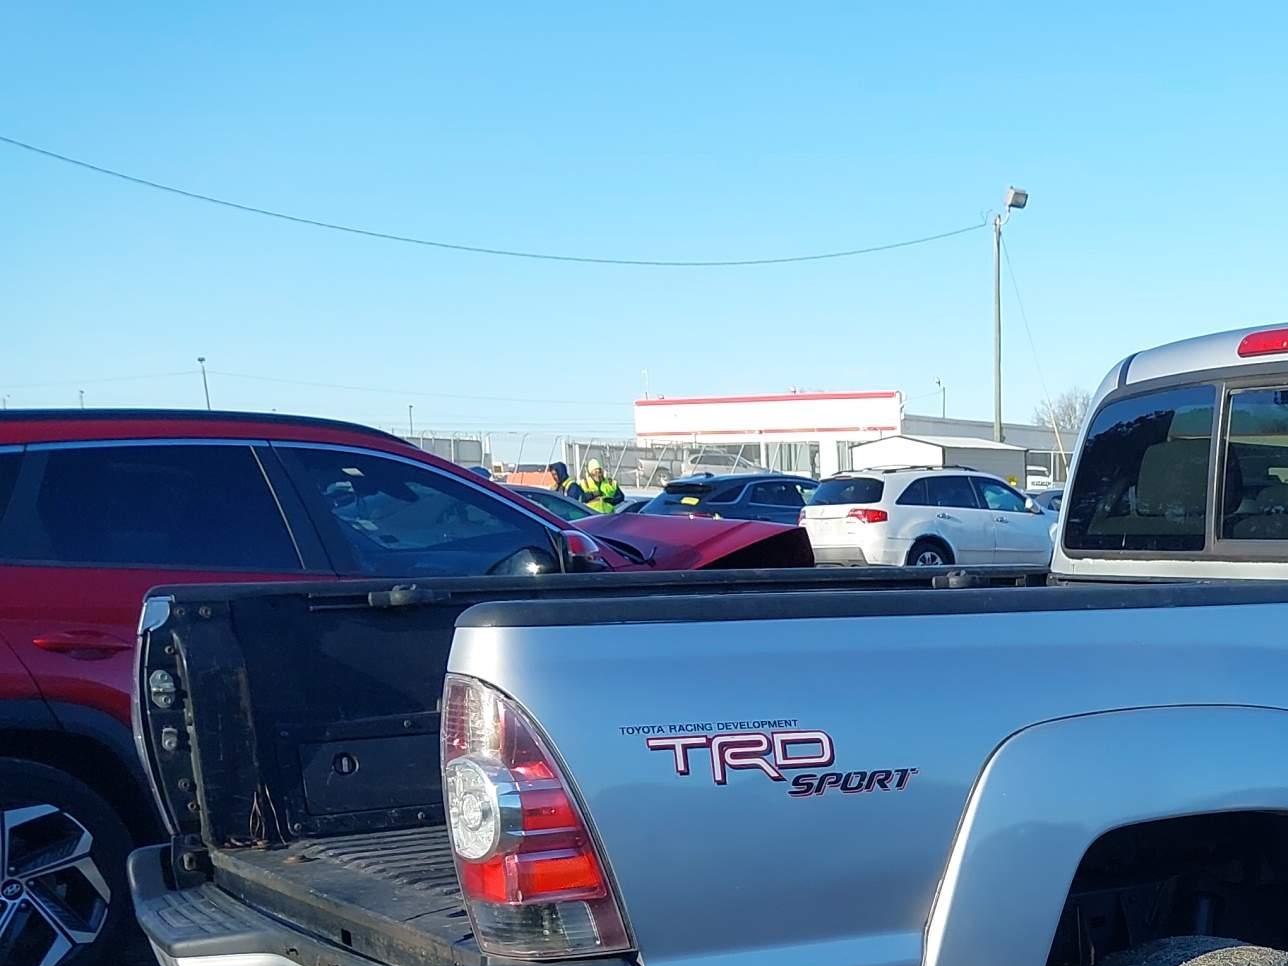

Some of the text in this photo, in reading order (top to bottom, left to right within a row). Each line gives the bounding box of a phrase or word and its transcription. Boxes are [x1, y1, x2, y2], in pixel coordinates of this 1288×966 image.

[619, 719, 798, 735] TOYOTA RACING DEVELOPMENT
[646, 730, 835, 785] TRD
[787, 767, 919, 797] SPORT
